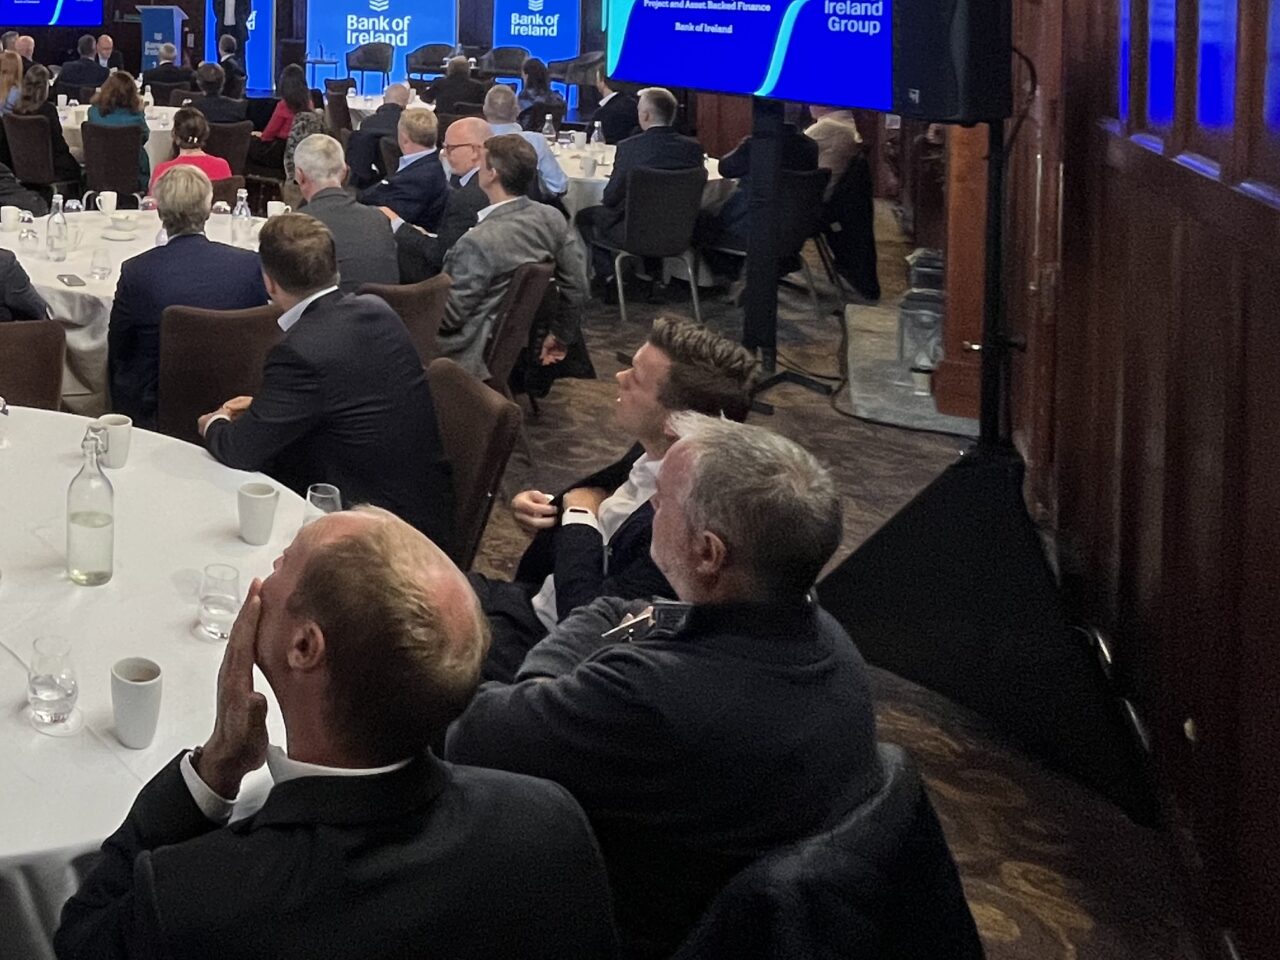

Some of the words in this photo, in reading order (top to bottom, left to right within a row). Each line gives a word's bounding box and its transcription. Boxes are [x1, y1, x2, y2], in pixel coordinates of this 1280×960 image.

[644, 0, 670, 10] Project
[670, 0, 684, 9] and
[738, 2, 772, 12] Finance
[824, 0, 884, 16] Ireland
[346, 14, 390, 30] Bank
[392, 16, 412, 31] of
[510, 12, 544, 25] Bank
[544, 13, 560, 26] of
[828, 16, 881, 36] Group
[510, 24, 558, 36] Ireland
[674, 22, 694, 32] Bank
[695, 22, 704, 32] of
[704, 24, 733, 34] Ireland
[346, 30, 408, 46] Ireland
